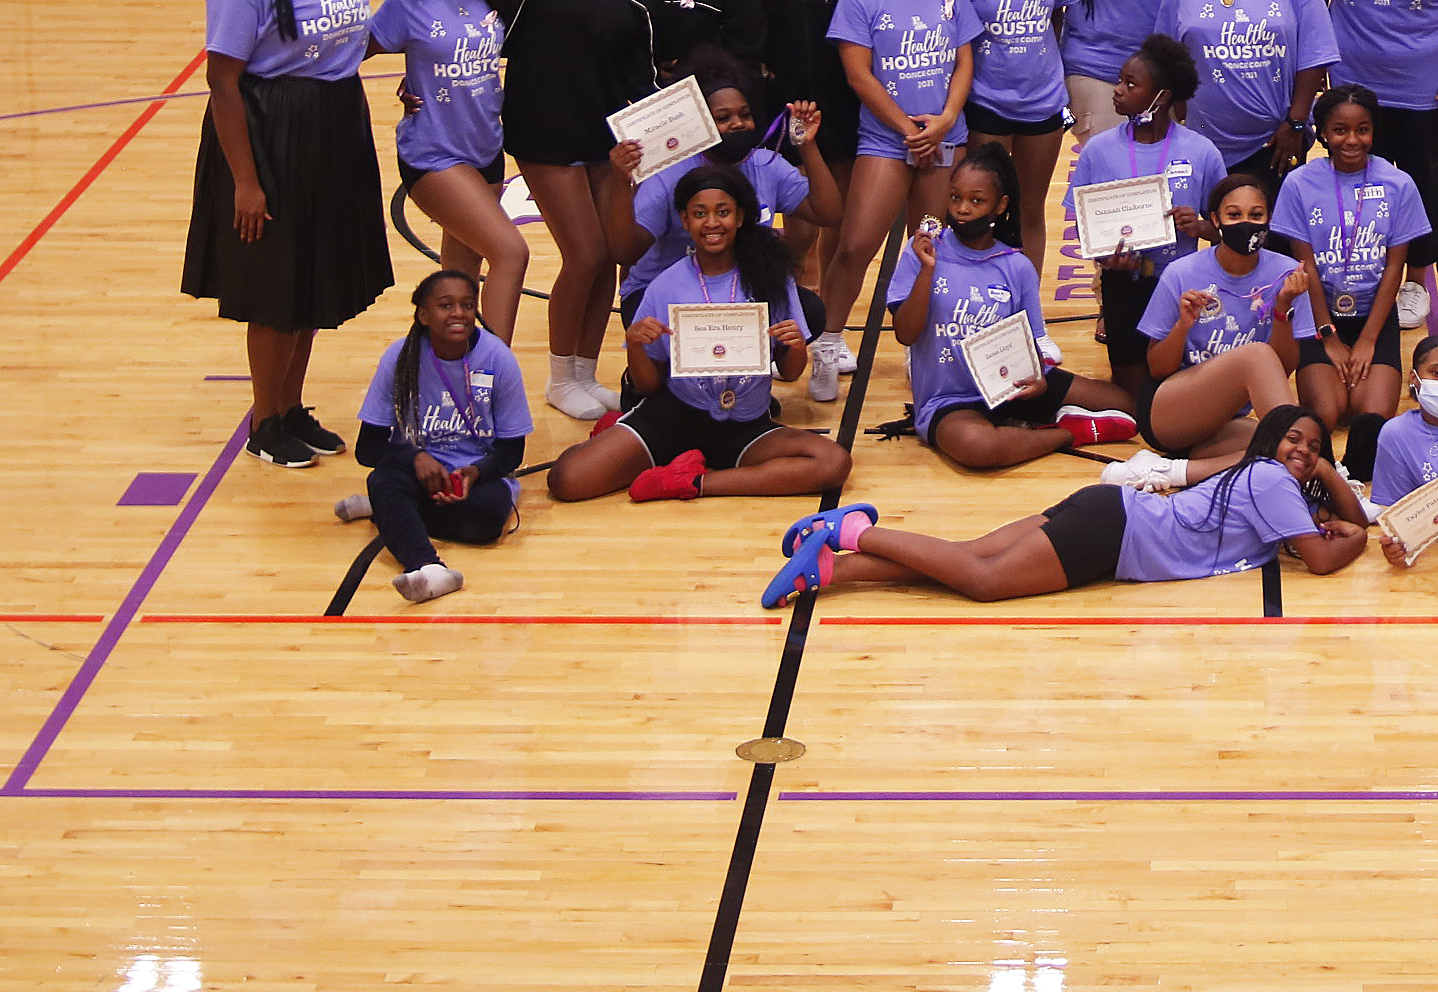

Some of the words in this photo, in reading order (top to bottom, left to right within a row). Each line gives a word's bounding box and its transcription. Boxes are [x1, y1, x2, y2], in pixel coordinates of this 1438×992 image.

[900, 23, 949, 55] Healthy
[1220, 19, 1276, 49] Healthy
[881, 48, 956, 70] HOUSTON
[1203, 44, 1286, 59] HOUSTON
[434, 57, 499, 77] HOUSTO
